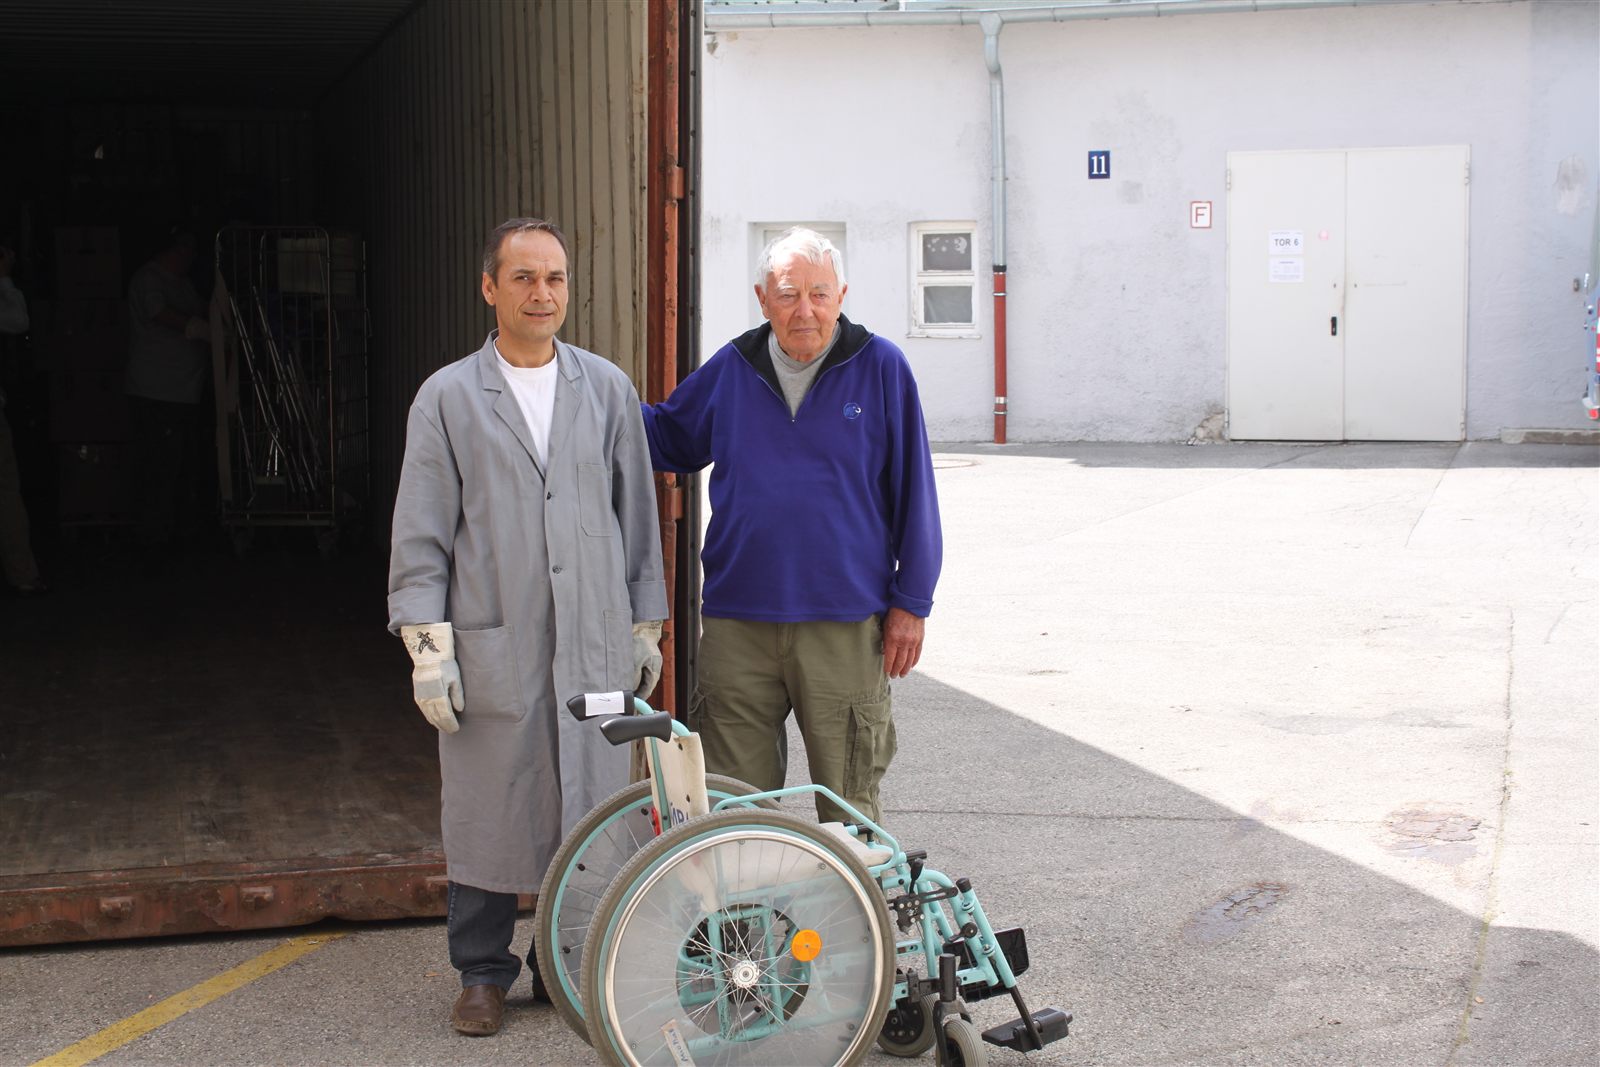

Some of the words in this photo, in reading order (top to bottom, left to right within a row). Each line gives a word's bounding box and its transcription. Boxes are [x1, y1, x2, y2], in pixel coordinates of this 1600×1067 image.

[1091, 155, 1107, 175] 11
[1195, 206, 1207, 223] F
[1274, 238, 1291, 247] TOR
[1293, 238, 1300, 247] 6
